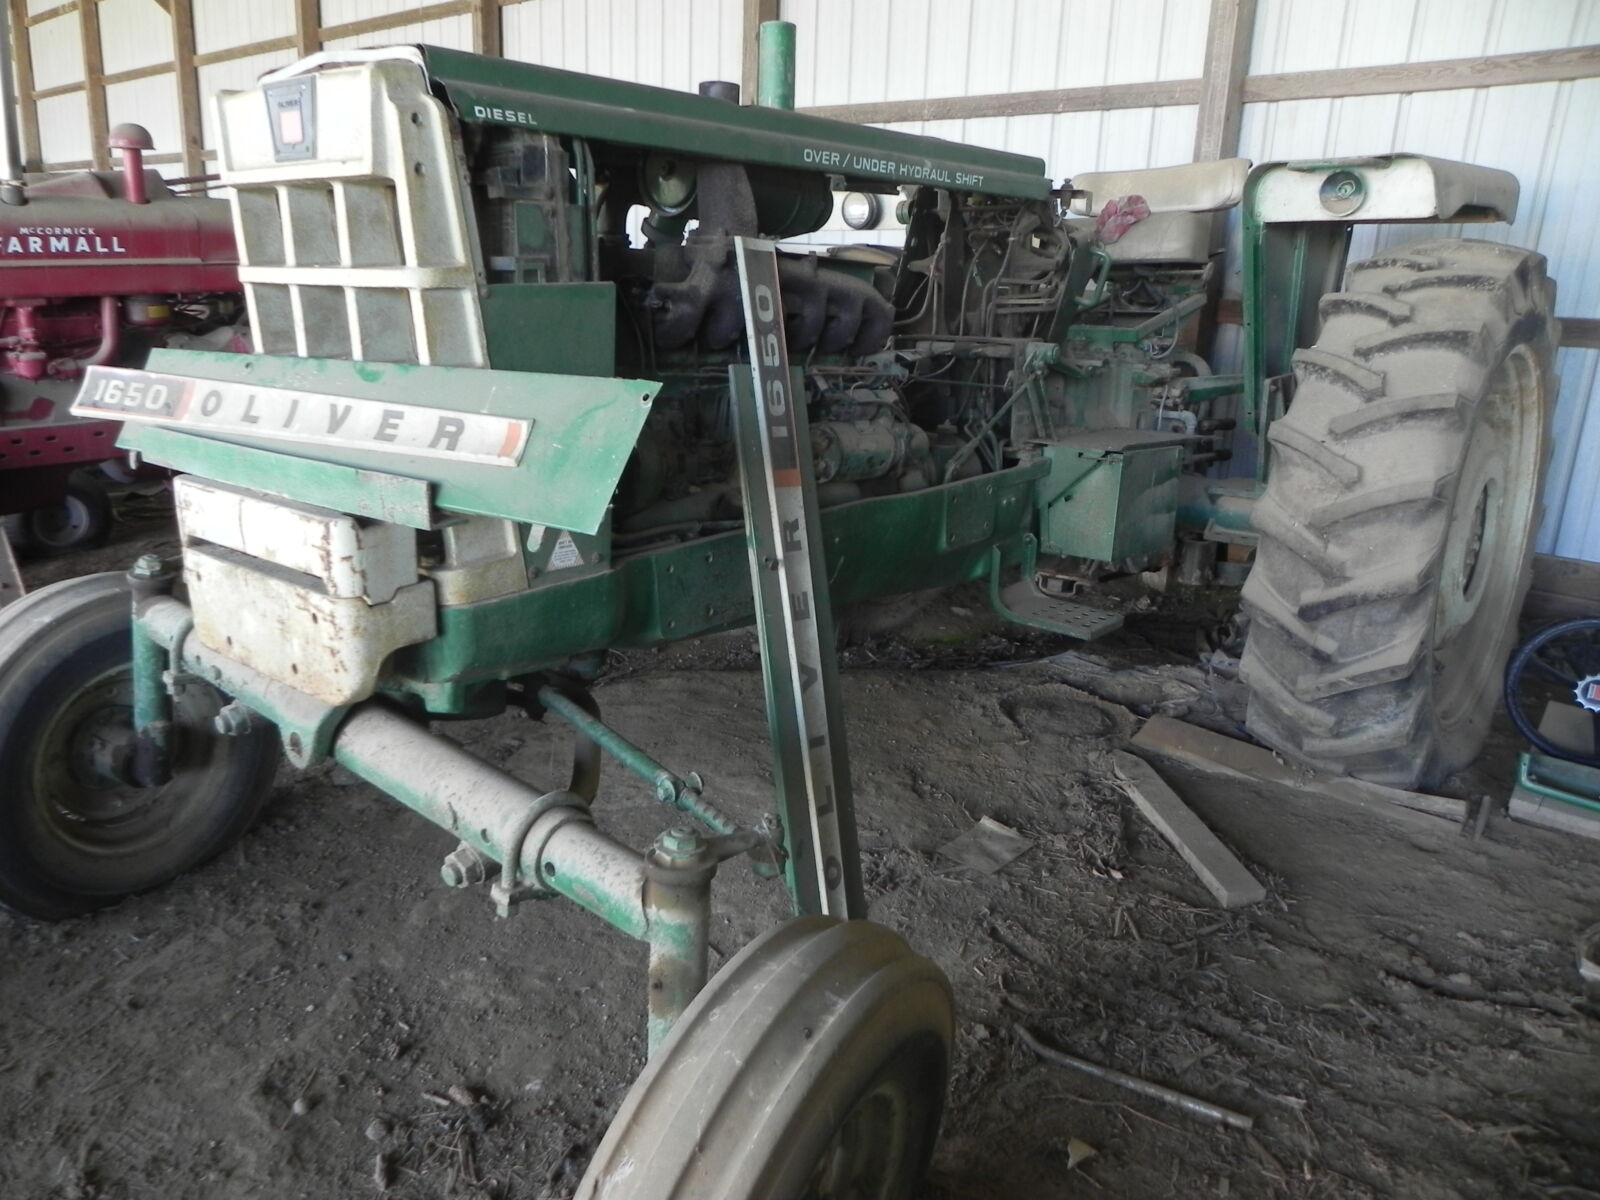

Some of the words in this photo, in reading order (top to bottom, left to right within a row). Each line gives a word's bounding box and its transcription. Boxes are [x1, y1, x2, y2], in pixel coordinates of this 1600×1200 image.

[474, 105, 537, 125] DIESEL
[899, 163, 951, 183] HYDRAUL
[955, 172, 984, 188] SHIFT
[0, 236, 126, 253] ARMALL
[754, 283, 789, 438] 1650
[94, 379, 168, 410] 1650
[199, 395, 466, 452] OLIVER
[782, 517, 843, 891] OLIVER
